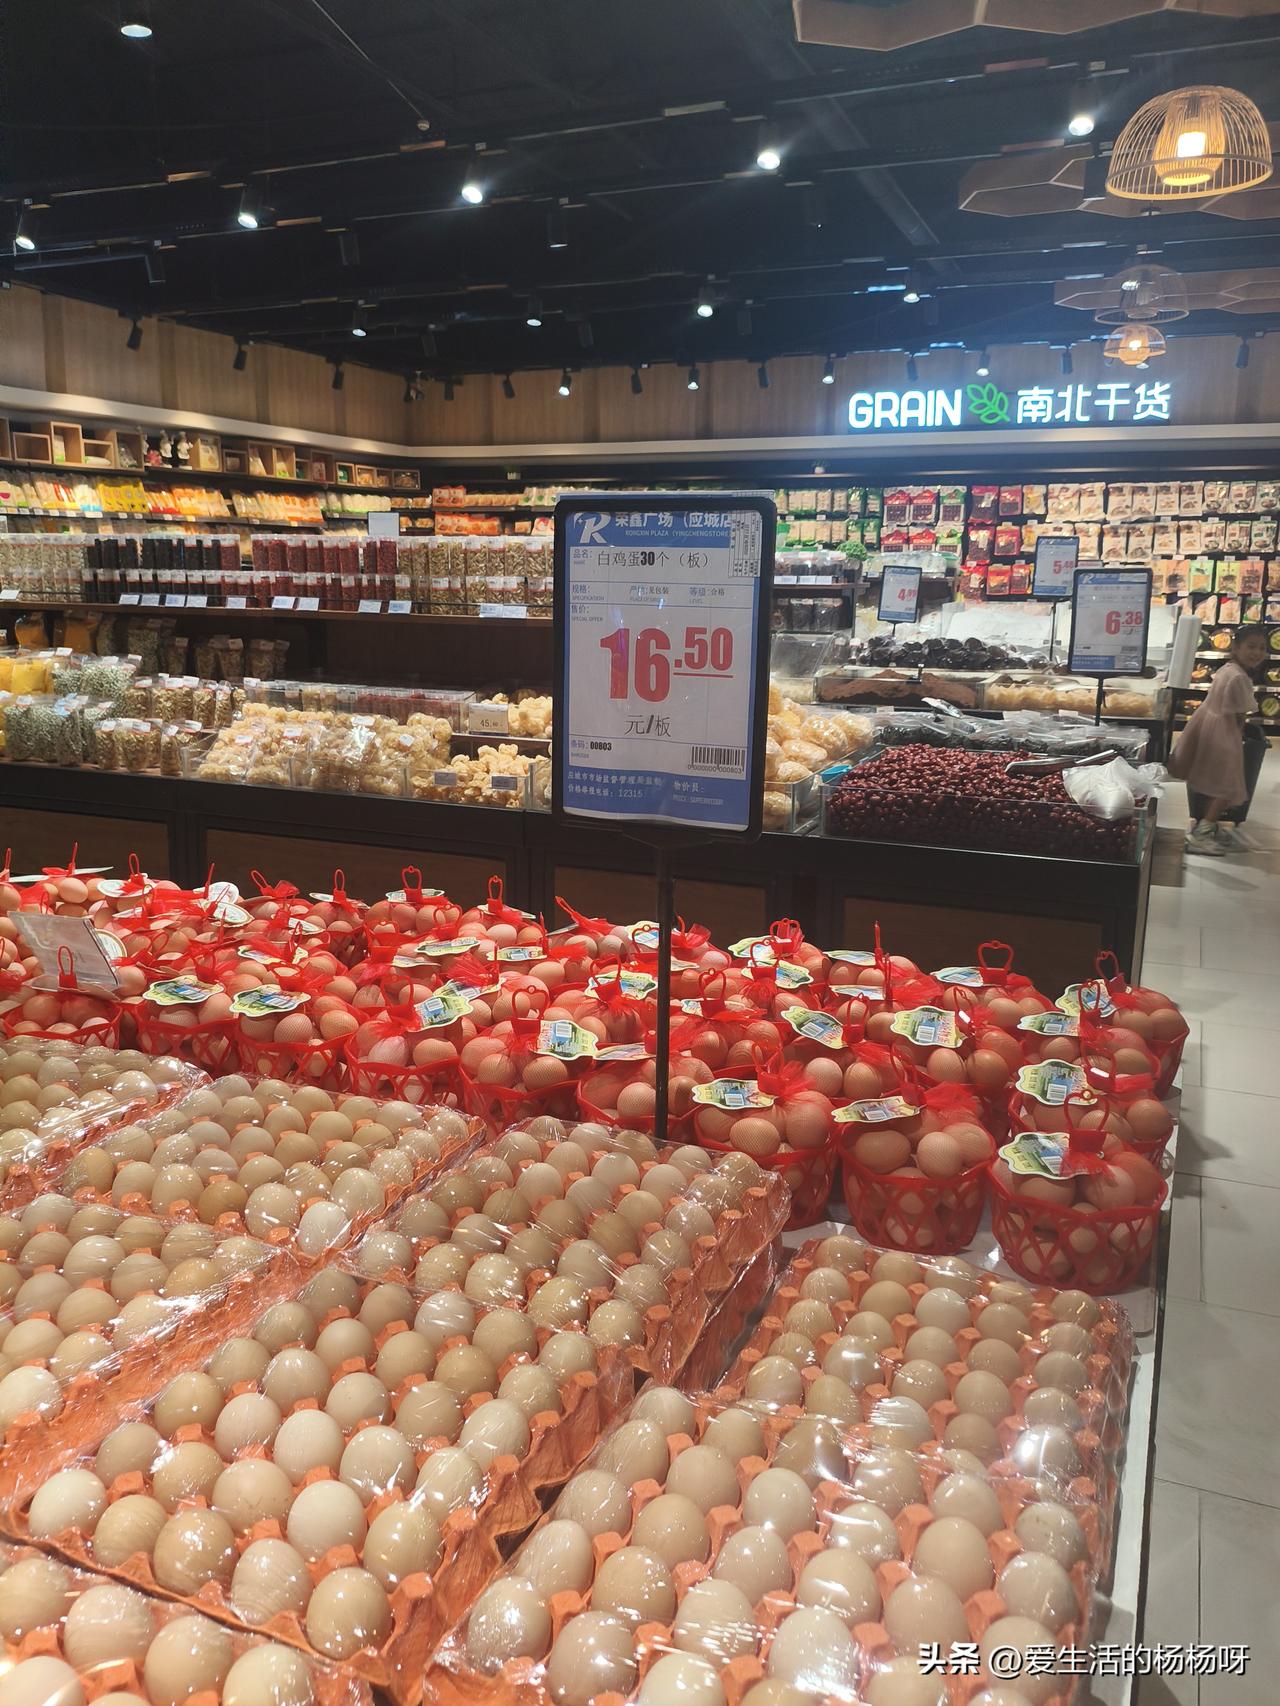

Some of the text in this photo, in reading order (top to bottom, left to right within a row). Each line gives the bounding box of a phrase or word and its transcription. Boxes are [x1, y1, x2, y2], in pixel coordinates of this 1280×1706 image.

[848, 389, 962, 429] GRAIN
[1017, 381, 1172, 425] 南北干货
[597, 550, 710, 568] 白鸡蛋30个（板）
[1105, 610, 1143, 635] 6.38
[600, 626, 734, 703] 16.50
[624, 715, 672, 737] 元/板
[590, 740, 612, 751] 00803
